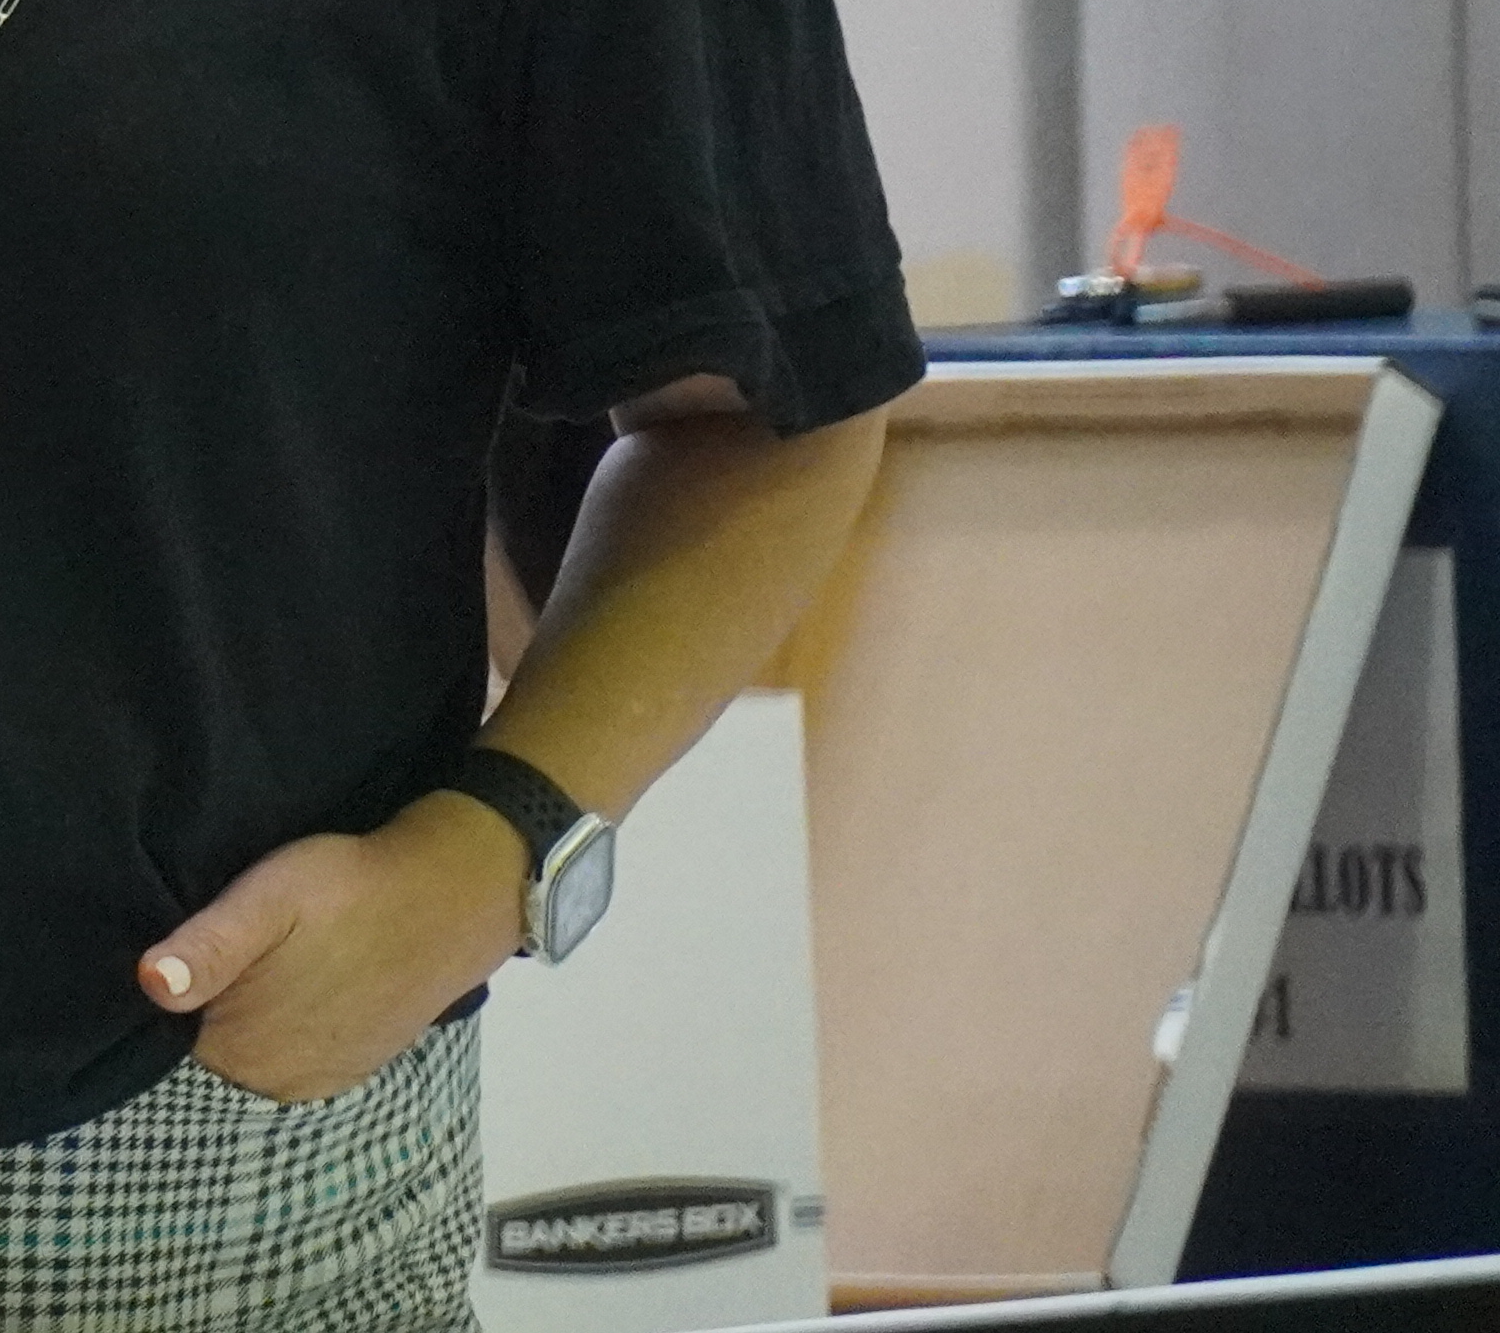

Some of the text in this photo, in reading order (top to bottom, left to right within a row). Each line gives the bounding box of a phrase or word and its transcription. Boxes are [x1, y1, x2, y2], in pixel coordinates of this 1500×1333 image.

[1292, 843, 1428, 918] LOTS
[501, 1206, 678, 1255] BANKERS
[682, 1200, 762, 1240] BOX
